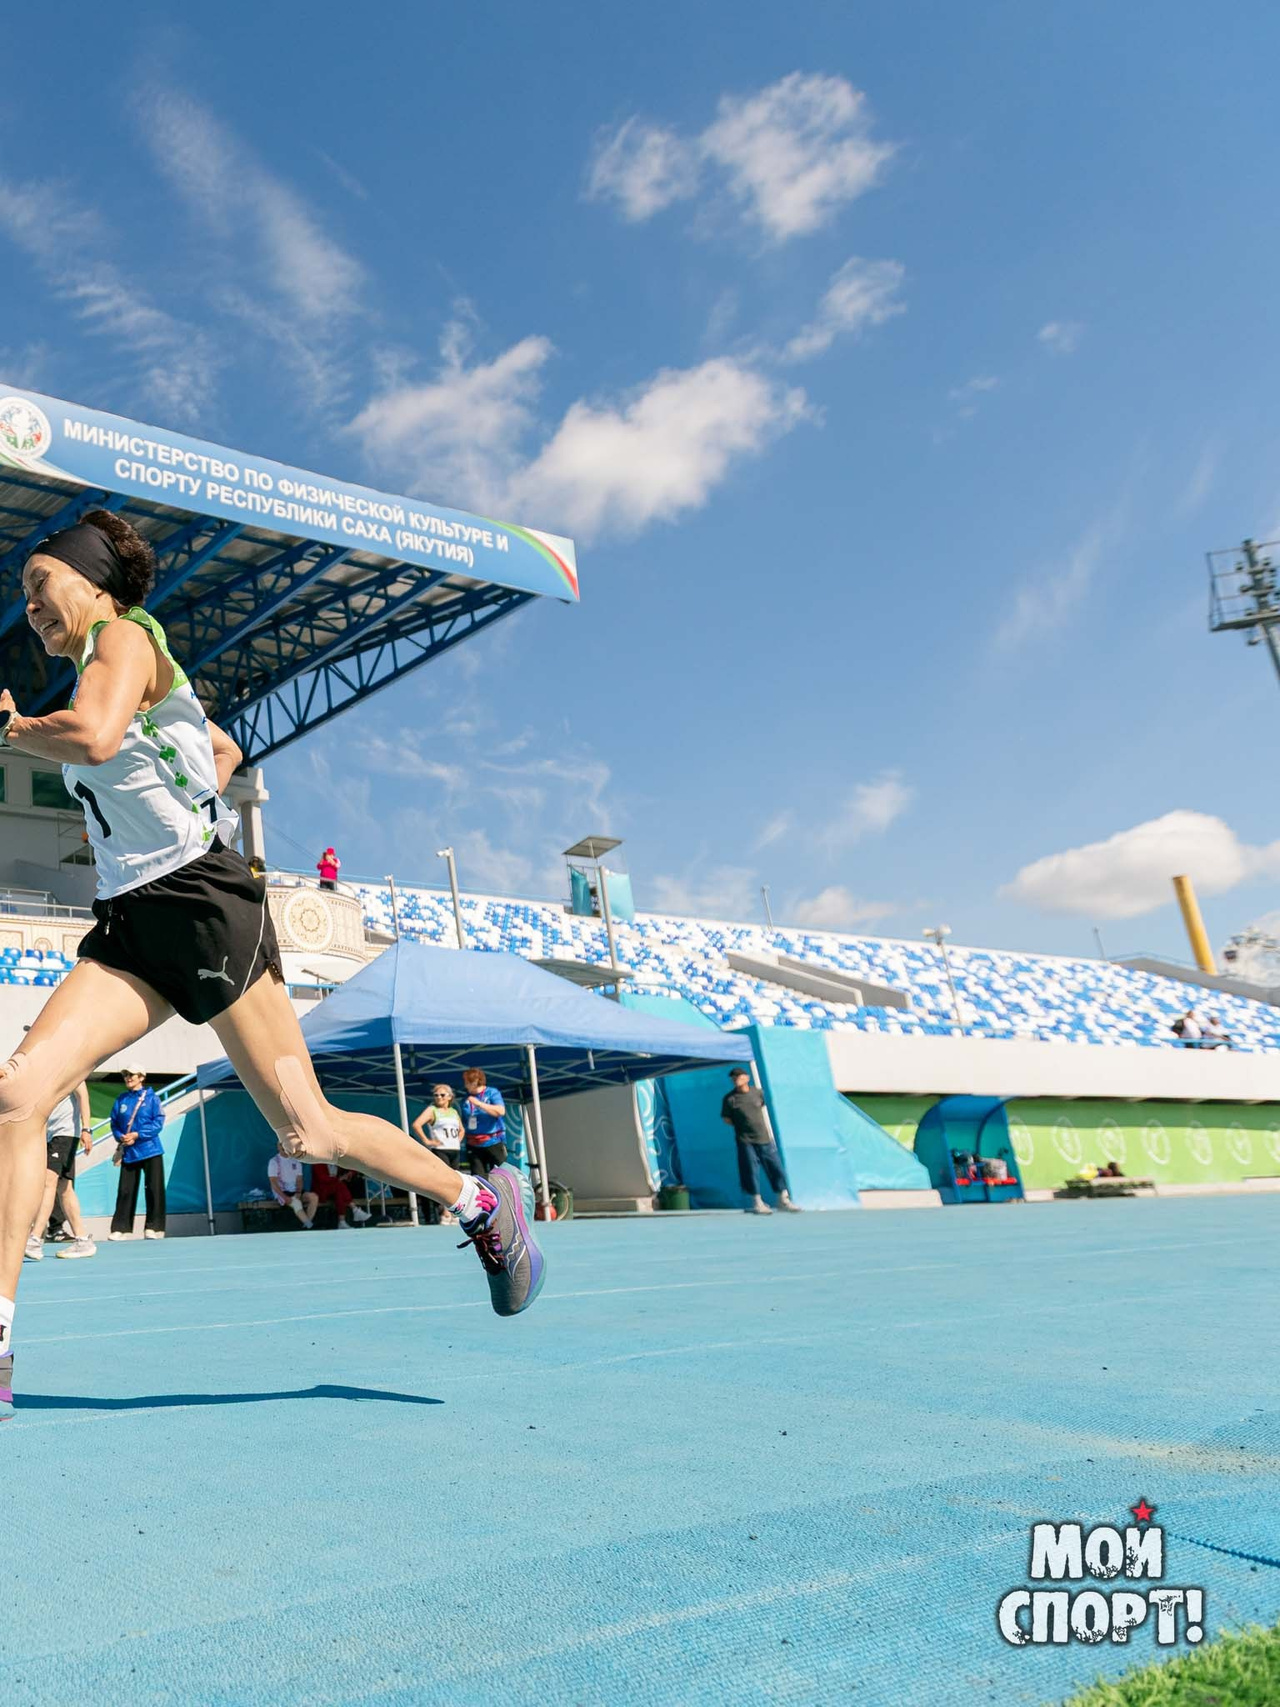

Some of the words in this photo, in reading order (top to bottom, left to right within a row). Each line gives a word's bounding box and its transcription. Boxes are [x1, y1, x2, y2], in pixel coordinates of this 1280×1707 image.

[64, 418, 240, 483] МИНИСТЕРСТВО
[244, 469, 273, 490] ПО
[278, 477, 406, 526] ФИЗИЧЕСКОЙ
[408, 510, 494, 549] КУЛЬТУРЕ
[495, 533, 510, 553] И
[114, 458, 202, 496] СПОРТУ
[205, 481, 338, 532] РЕСПУБЛИКИ
[341, 516, 393, 544] САХА
[395, 529, 475, 568] (ЯКУТИЯ)
[443, 1128, 459, 1138] 10
